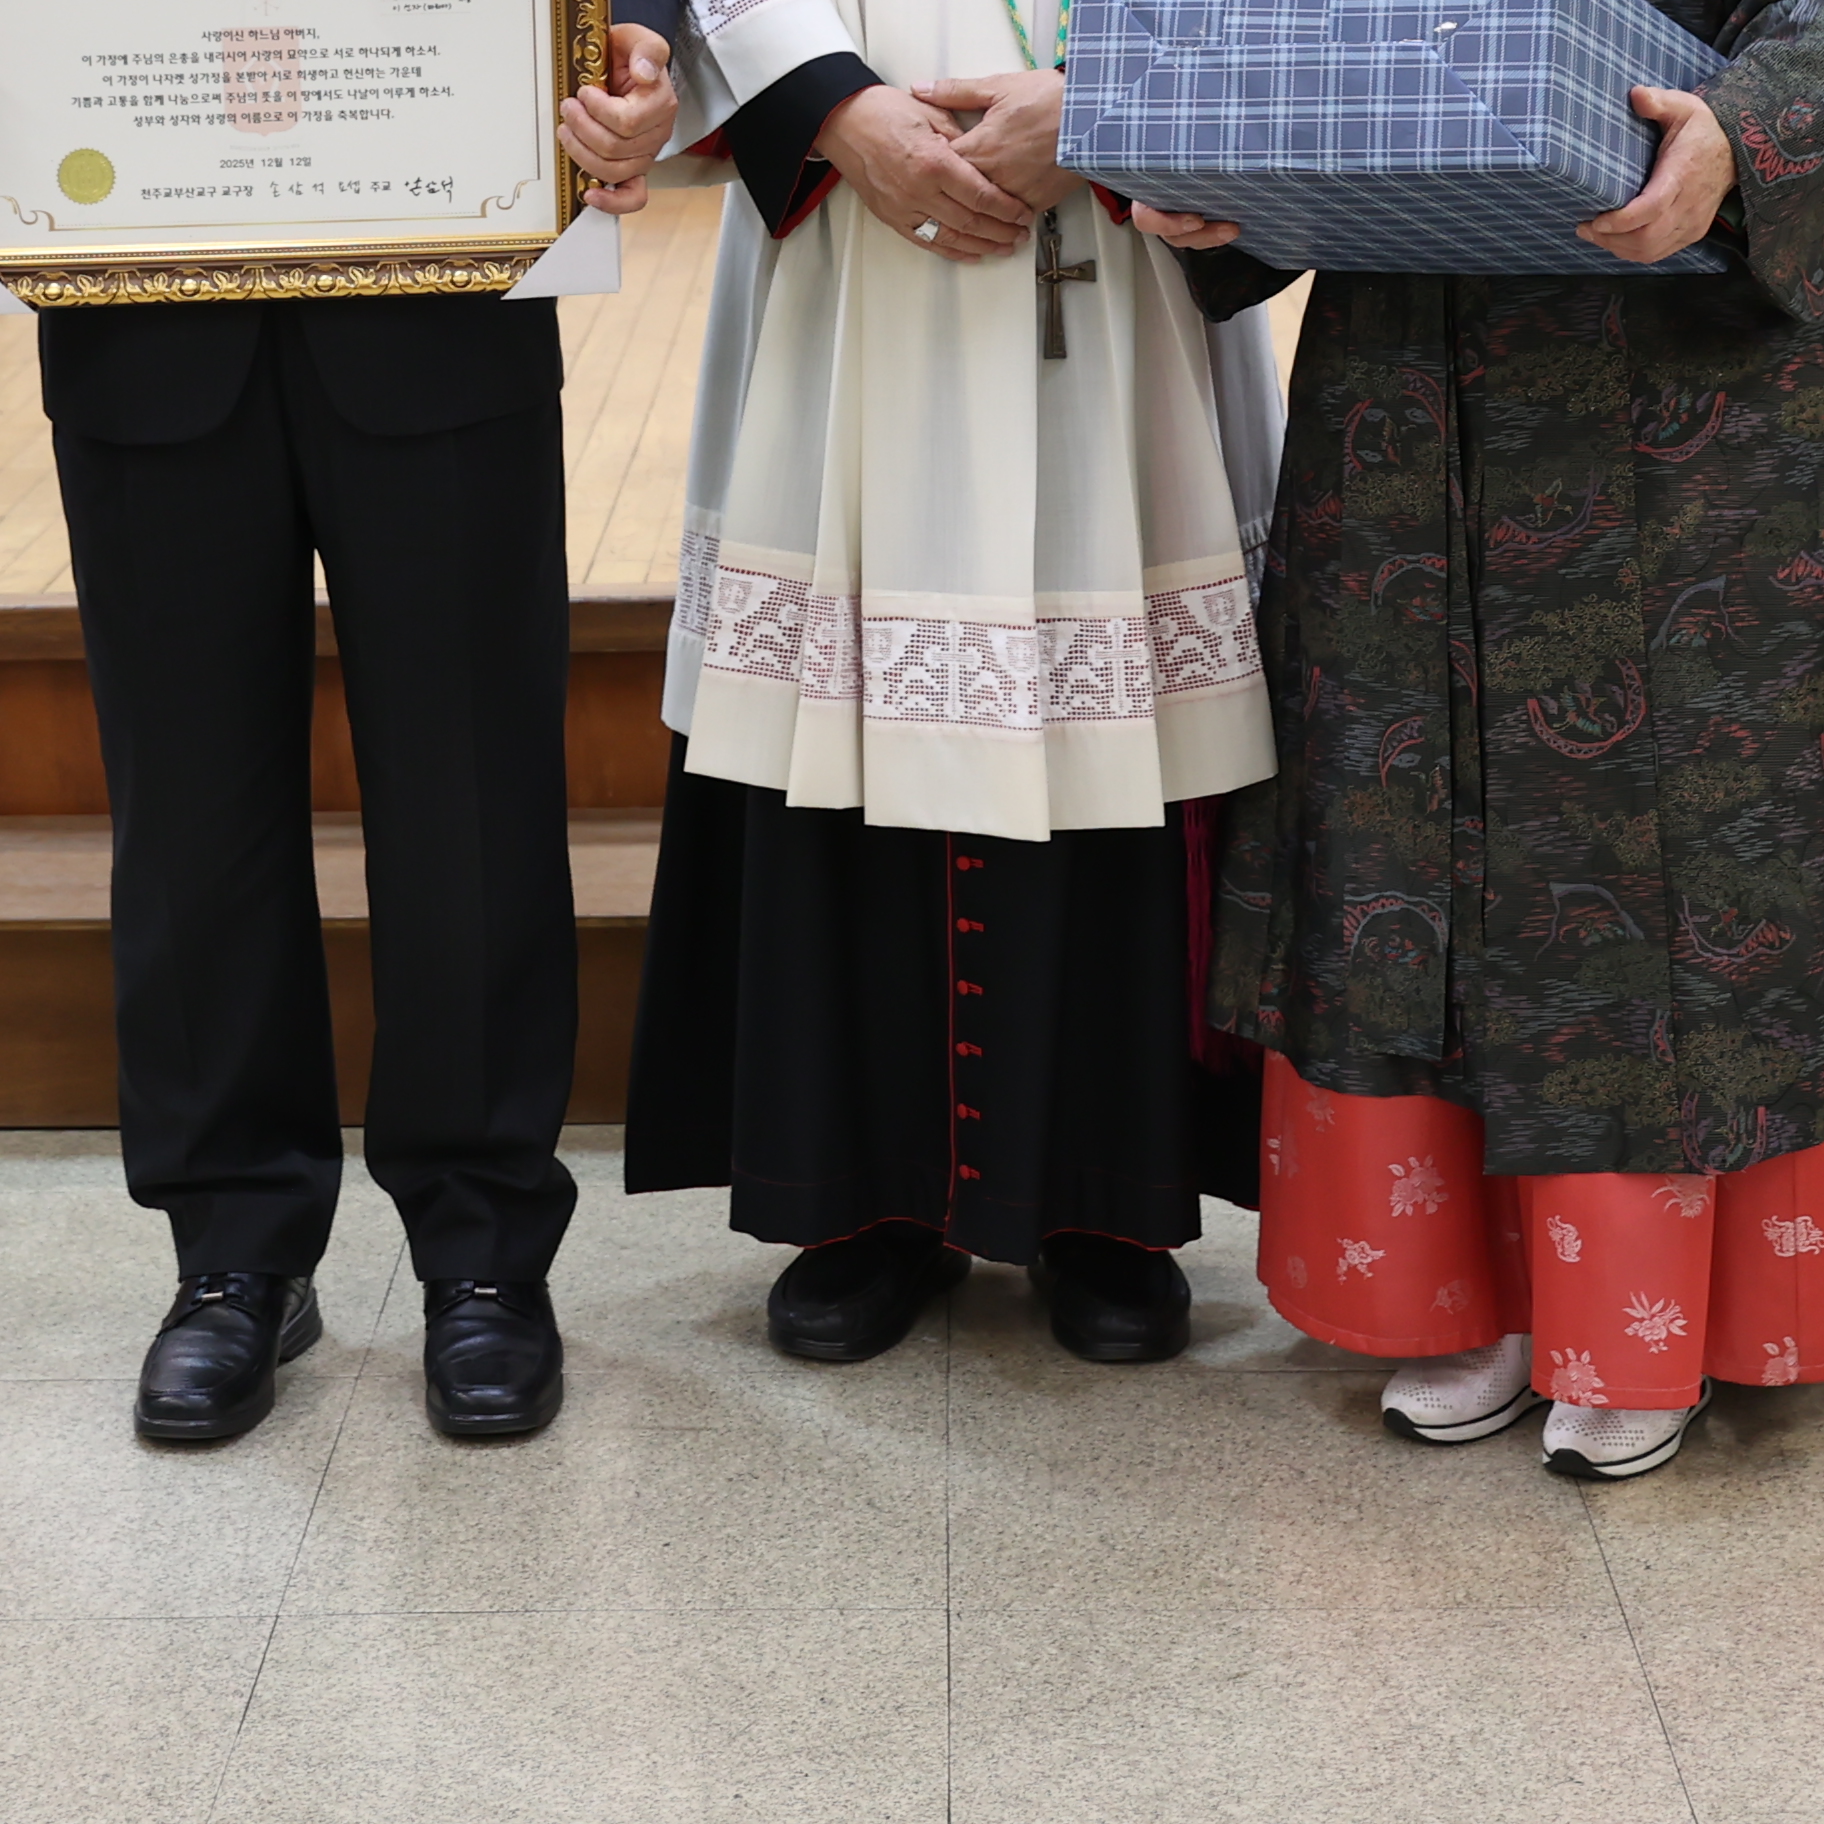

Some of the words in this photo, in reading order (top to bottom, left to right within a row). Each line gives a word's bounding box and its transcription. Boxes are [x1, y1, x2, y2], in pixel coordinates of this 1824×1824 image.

[201, 31, 244, 42] 사랑이신
[248, 29, 280, 41] 하느님
[283, 28, 320, 40] 아버지,
[81, 55, 92, 66] 이
[96, 54, 128, 66] 가정에
[132, 53, 164, 65] 주님의
[168, 52, 200, 64] 은총을
[204, 51, 246, 62] 내리시어
[251, 49, 283, 61] 사랑의
[333, 47, 355, 59] 서로
[359, 46, 401, 58] 하나되게
[405, 45, 440, 56] 하소서.
[102, 75, 113, 86] 이
[117, 74, 149, 86] 가정이
[152, 73, 185, 85] 나자렛
[188, 72, 231, 84] 성가정을
[236, 71, 267, 83] 본받아
[271, 69, 292, 81] 서로
[297, 68, 339, 80] 희생하고
[343, 68, 385, 79] 헌신하는
[390, 66, 421, 78] 가운데
[107, 95, 139, 107] 고통을
[143, 94, 165, 105] 함께
[225, 92, 257, 103] 주님의
[261, 91, 283, 102] 뜻을
[287, 90, 297, 101] 이
[301, 89, 344, 101] 땅에서도
[347, 88, 379, 99] 나날이
[383, 87, 415, 99] 이루게
[419, 86, 454, 97] 하소서.
[133, 115, 165, 127] 성부와
[169, 114, 201, 126] 성자와
[205, 113, 236, 125] 성령의
[241, 112, 284, 124] 이름으로
[287, 111, 298, 122] 이
[302, 110, 333, 122] 가정을
[337, 108, 394, 120] 축복합니다.
[219, 158, 255, 169] 2025년
[261, 157, 283, 168] 12월
[289, 156, 312, 167] 12일
[140, 186, 217, 200] 천주교부산교구
[221, 185, 254, 197] 교구장
[370, 180, 392, 193] 주교
